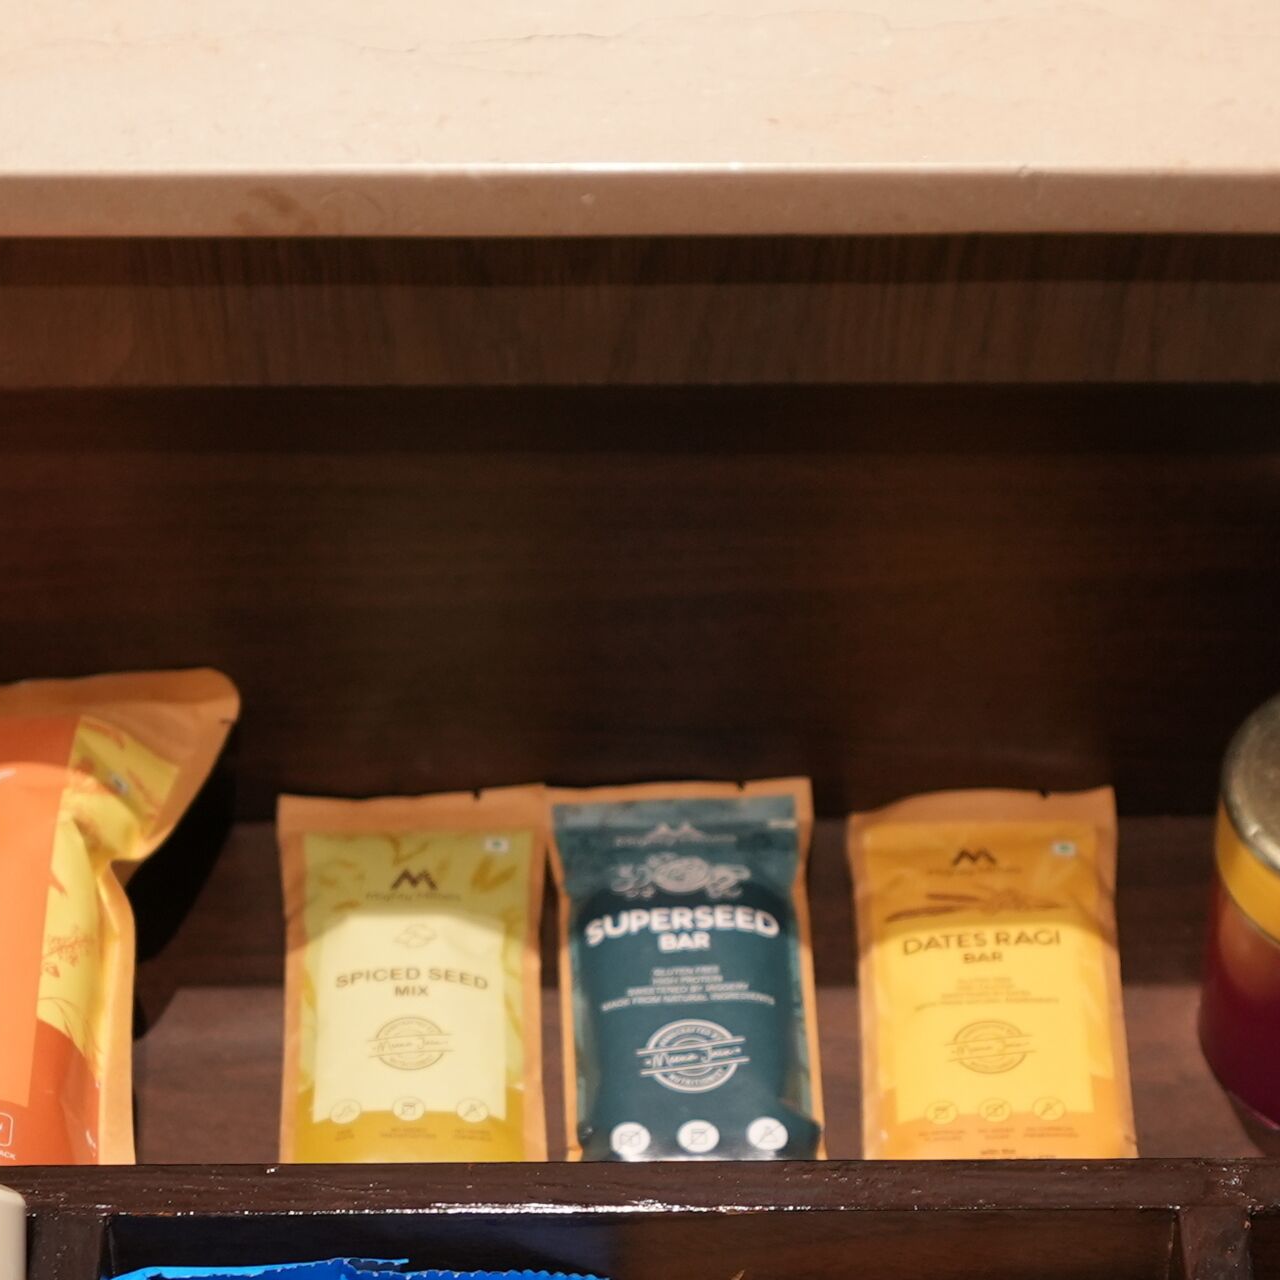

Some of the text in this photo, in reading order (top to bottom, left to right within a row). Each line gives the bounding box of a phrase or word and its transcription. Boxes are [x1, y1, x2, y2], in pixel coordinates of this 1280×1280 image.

[585, 905, 780, 947] SUPERSEED
[658, 931, 711, 952] BAR
[903, 929, 1061, 956] DATES RAGI
[963, 952, 1003, 964] BAR
[335, 967, 489, 990] SPICED SEED
[394, 985, 429, 997] MIX
